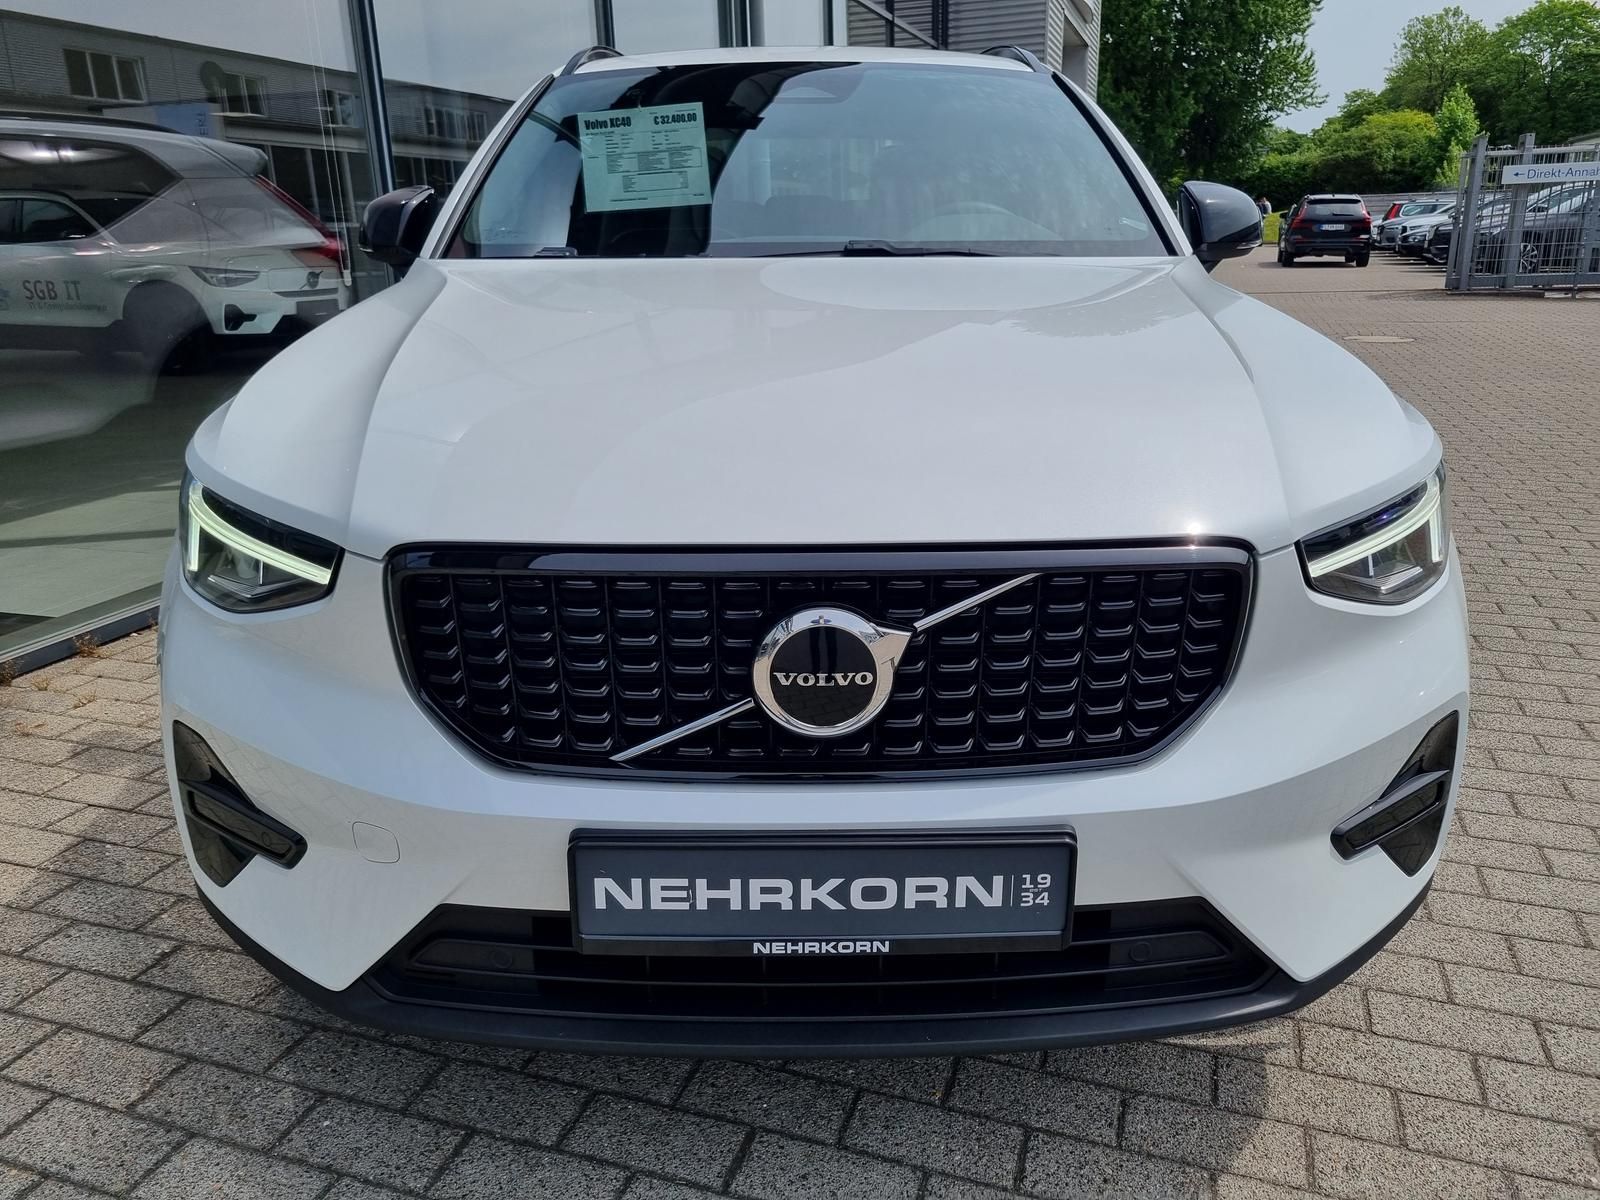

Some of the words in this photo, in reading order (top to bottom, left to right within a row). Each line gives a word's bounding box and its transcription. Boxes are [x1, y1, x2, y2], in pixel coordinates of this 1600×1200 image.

[584, 119, 608, 130] Volvo
[609, 116, 632, 128] XC40
[22, 280, 58, 300] SGB
[63, 280, 82, 300] IT
[773, 672, 874, 686] VOLVO
[593, 875, 1004, 910] NEHRKORN
[1021, 873, 1052, 888] 19
[1020, 891, 1050, 907] 34
[753, 941, 890, 954] NEHRKORN
